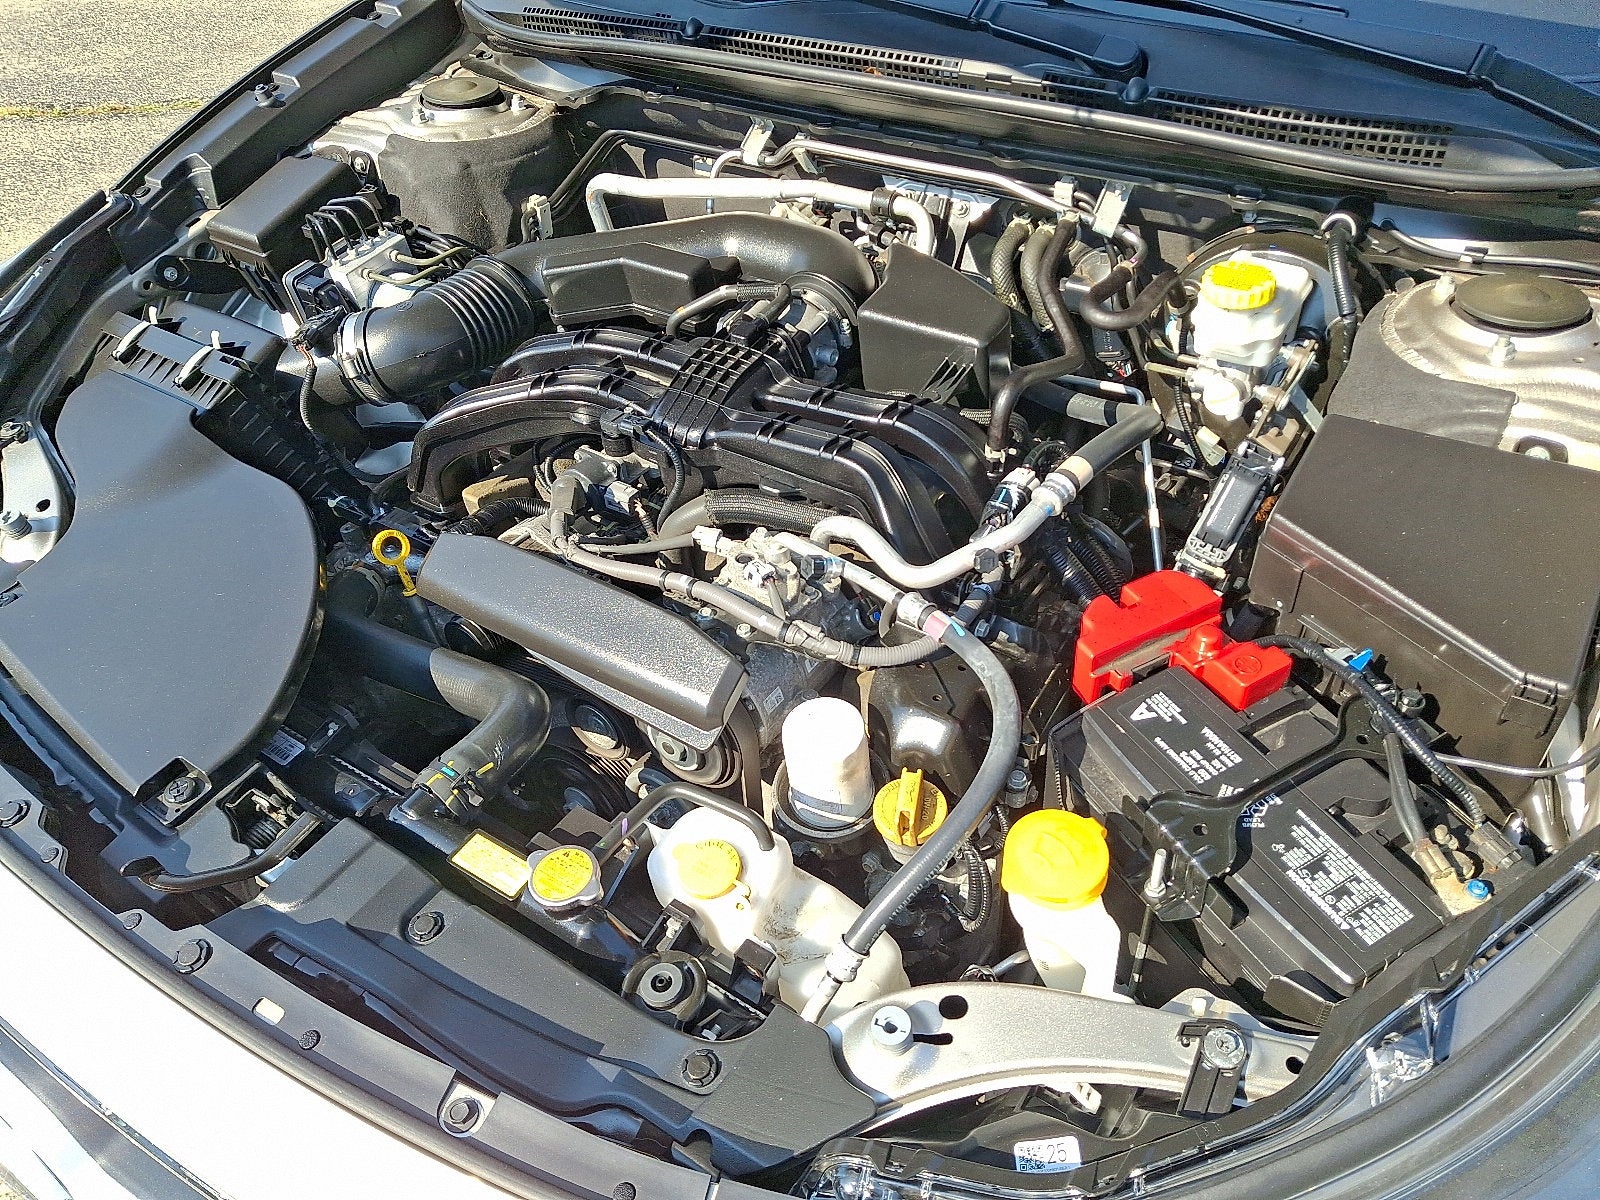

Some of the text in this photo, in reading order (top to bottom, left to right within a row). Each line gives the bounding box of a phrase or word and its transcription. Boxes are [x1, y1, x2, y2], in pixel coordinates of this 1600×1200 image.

[1178, 750, 1200, 769] AMPS
[1188, 770, 1205, 783] COLD
[1047, 1143, 1067, 1164] 25
